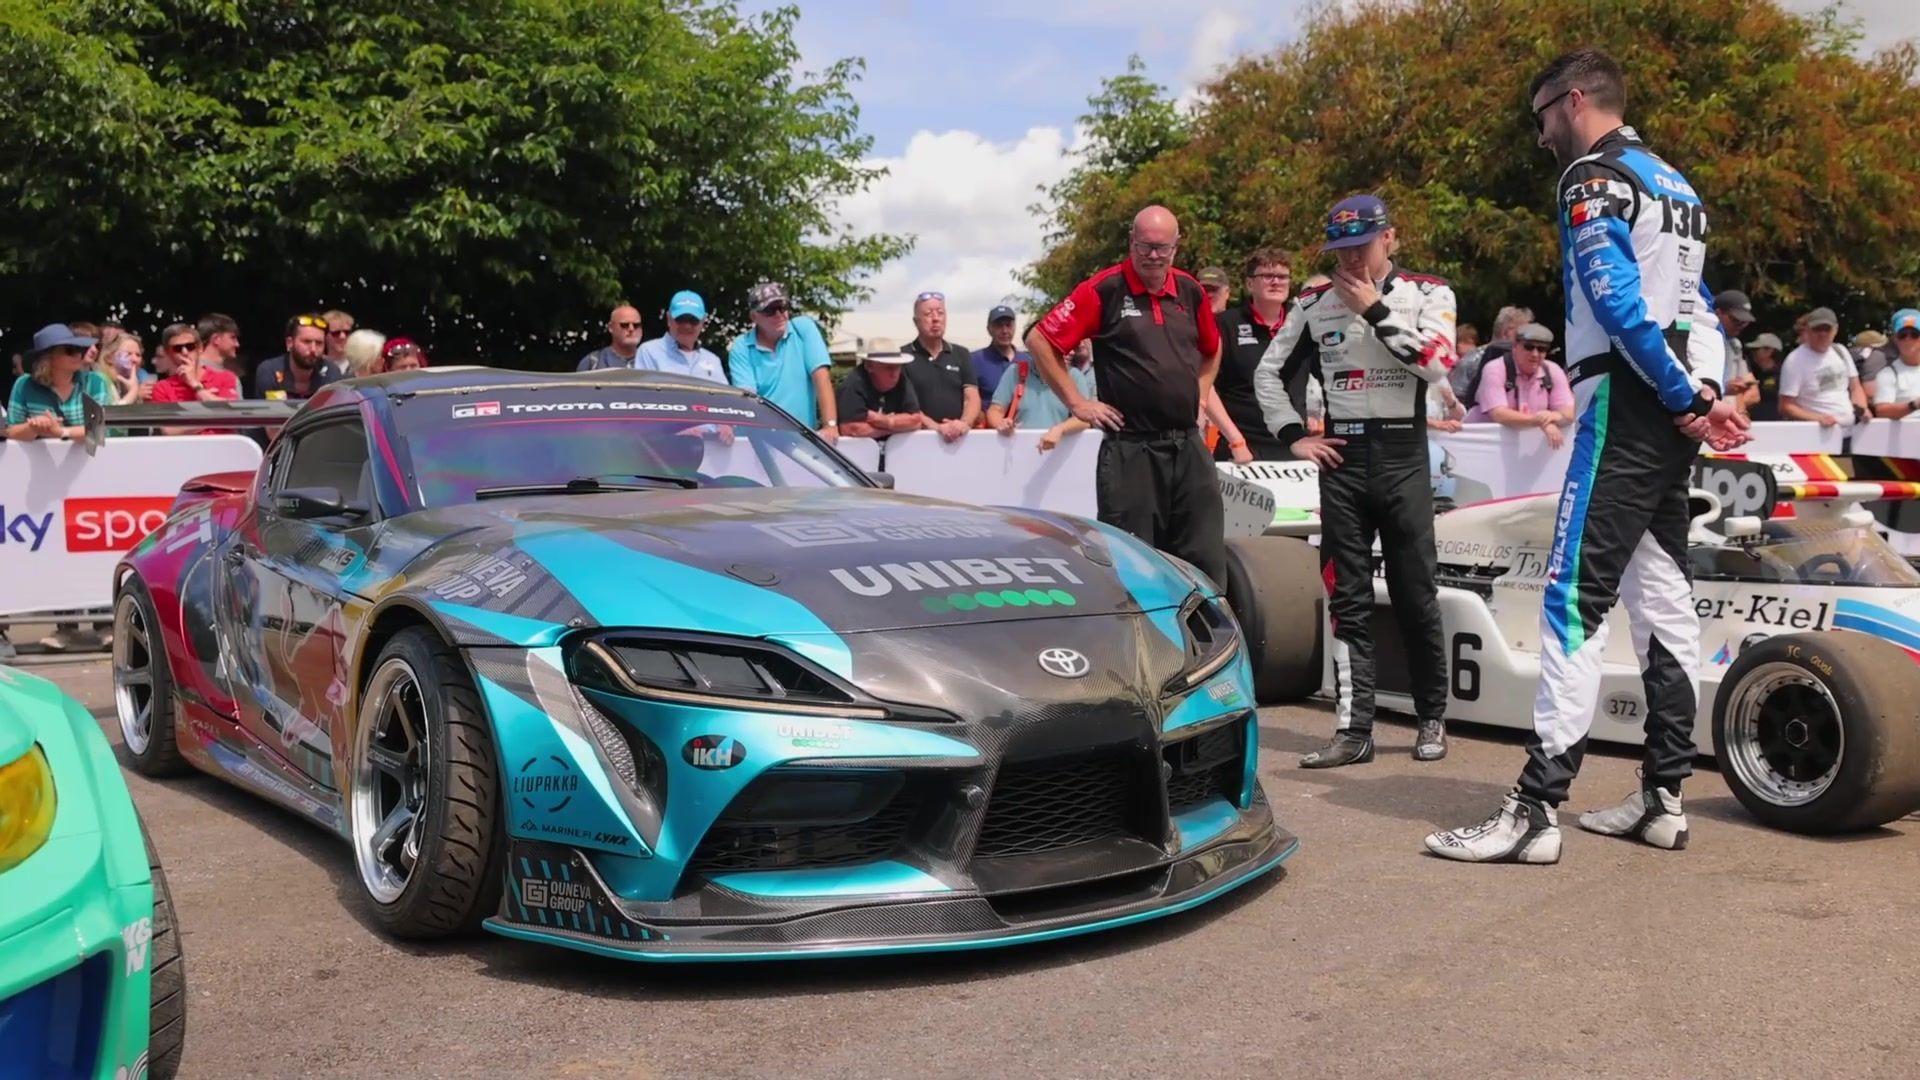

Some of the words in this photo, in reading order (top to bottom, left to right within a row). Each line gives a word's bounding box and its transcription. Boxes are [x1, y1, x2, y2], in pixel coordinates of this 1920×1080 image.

[1660, 196, 1706, 243] 130
[455, 404, 500, 417] GR
[507, 403, 604, 413] TOYOTA
[609, 402, 687, 411] GAZOO
[691, 404, 756, 417] Racing
[1230, 464, 1319, 482] illige
[0, 505, 54, 551] ky
[75, 510, 167, 547] spo
[1444, 541, 1512, 559] CIGARILLOS
[463, 553, 527, 598] NEVA
[829, 557, 1084, 597] UNIBET
[1691, 594, 1829, 631] er-Kiel
[1609, 699, 1637, 717] 372
[514, 775, 578, 793] LIUPAKKA
[594, 832, 633, 846] LYNX
[551, 881, 592, 899] OUNEVA
[549, 897, 586, 913] GROUP
